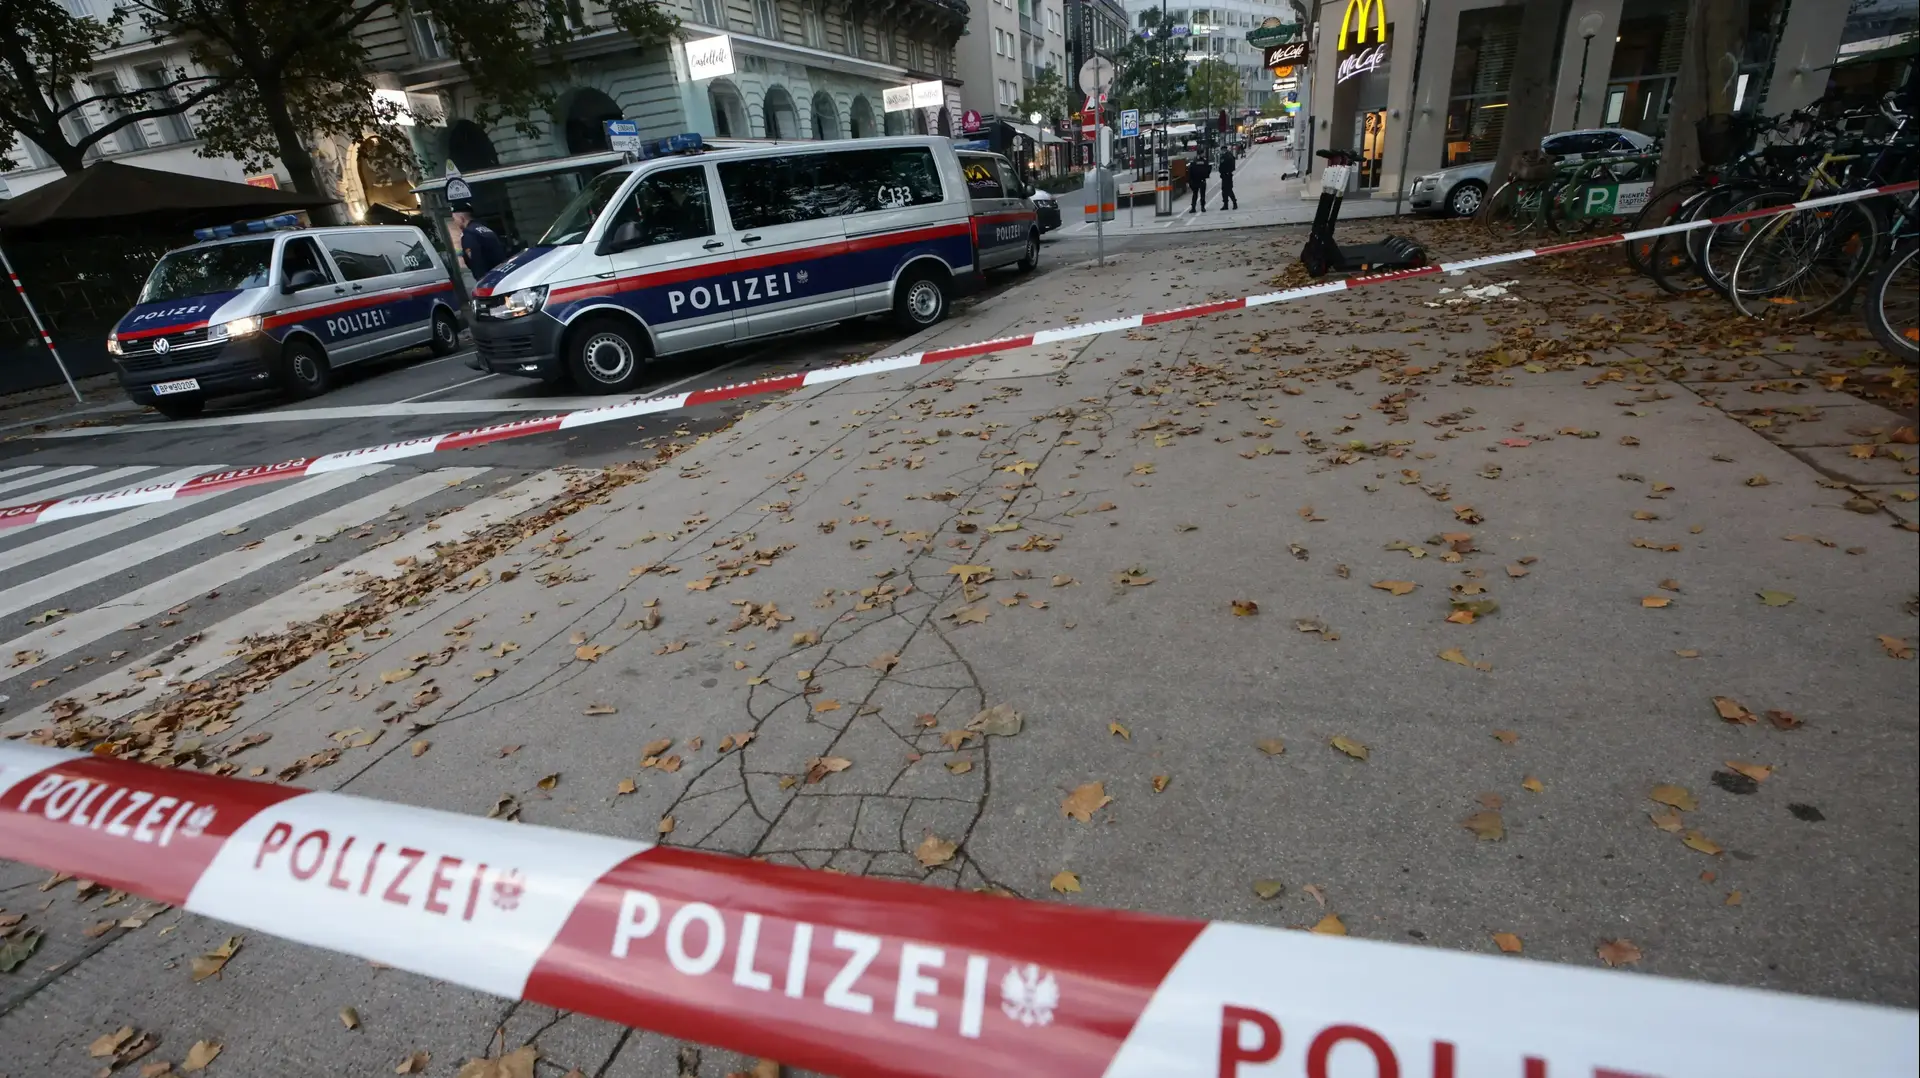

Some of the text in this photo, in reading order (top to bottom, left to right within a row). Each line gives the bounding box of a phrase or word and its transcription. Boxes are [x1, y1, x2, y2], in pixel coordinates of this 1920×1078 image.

[1337, 43, 1386, 82] McCafé
[888, 186, 912, 204] 133
[1585, 187, 1609, 214] P
[996, 224, 1021, 241] POLIZEI
[668, 272, 792, 314] POLIZEI
[133, 305, 207, 322] POLIZEI
[326, 309, 386, 337] POLIZEI
[214, 457, 307, 481] POLIZEI
[81, 481, 176, 504] POLIZEI
[18, 773, 187, 847] POLIZEI
[253, 821, 489, 922] POLIZEI
[610, 888, 989, 1039] POLIZEI
